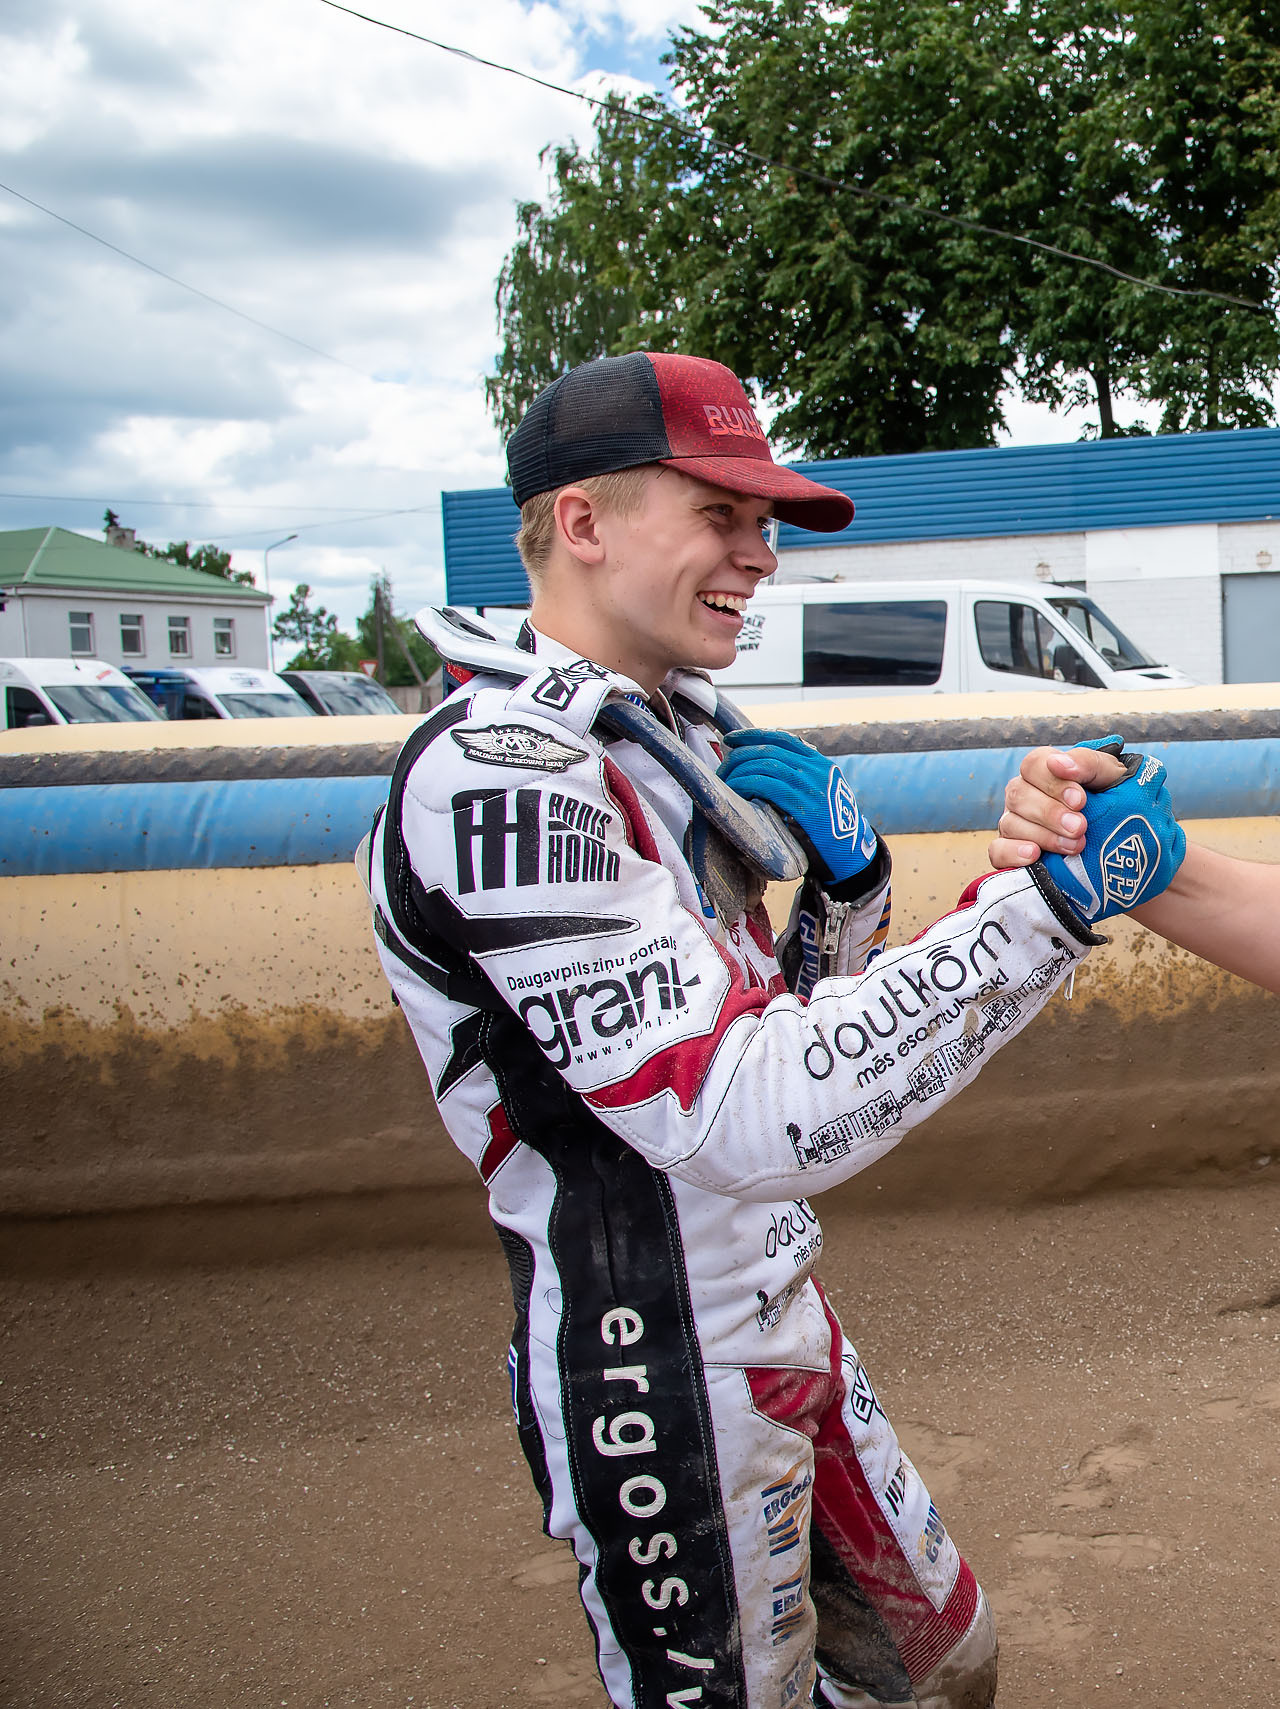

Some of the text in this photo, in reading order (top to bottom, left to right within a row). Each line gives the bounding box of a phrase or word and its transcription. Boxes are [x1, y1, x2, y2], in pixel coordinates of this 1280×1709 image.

[549, 792, 612, 840] ARNIS
[507, 961, 590, 991] Daugavpils
[593, 957, 625, 974] ziņu
[856, 1049, 896, 1089] mēs
[793, 1245, 810, 1268] mēs
